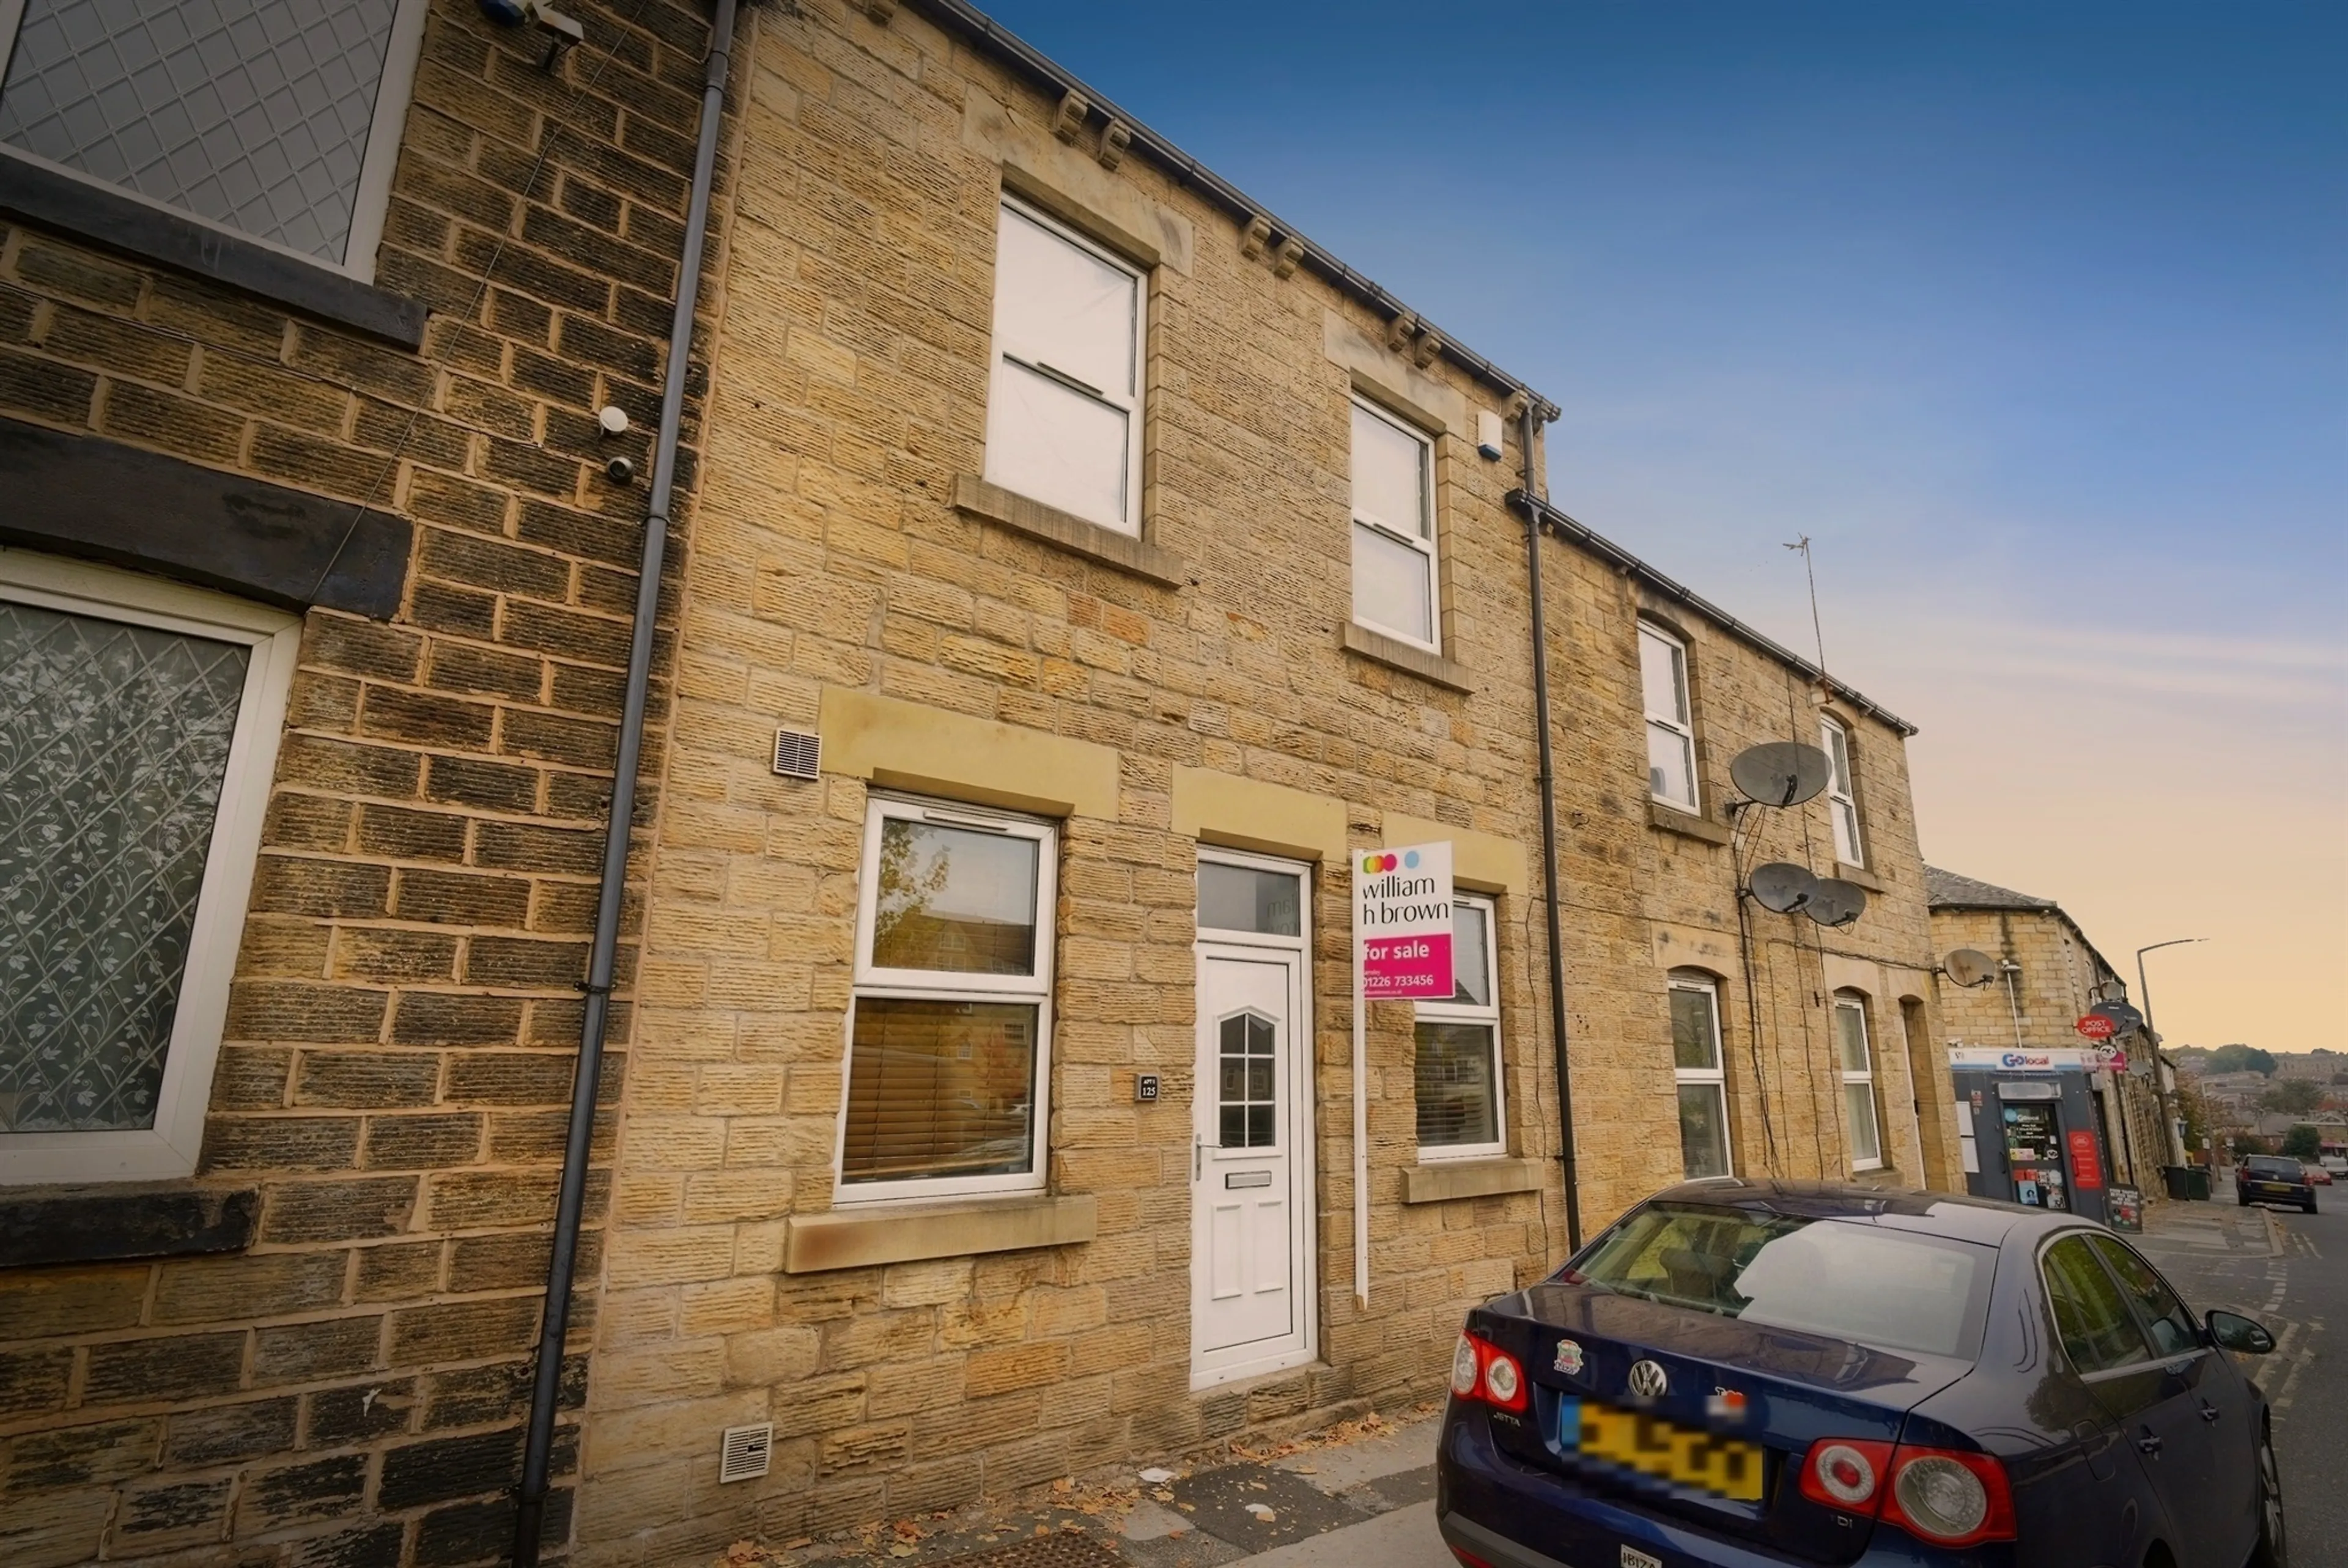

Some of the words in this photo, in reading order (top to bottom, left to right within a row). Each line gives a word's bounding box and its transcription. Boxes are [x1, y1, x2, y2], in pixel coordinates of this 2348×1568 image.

[1363, 875, 1434, 899] william
[1364, 903, 1375, 925] h
[1381, 901, 1449, 924] brown
[1393, 940, 1430, 960] sale
[1394, 974, 1434, 987] 733456
[1143, 1086, 1156, 1095] 125
[1493, 1412, 1521, 1427] JETTA
